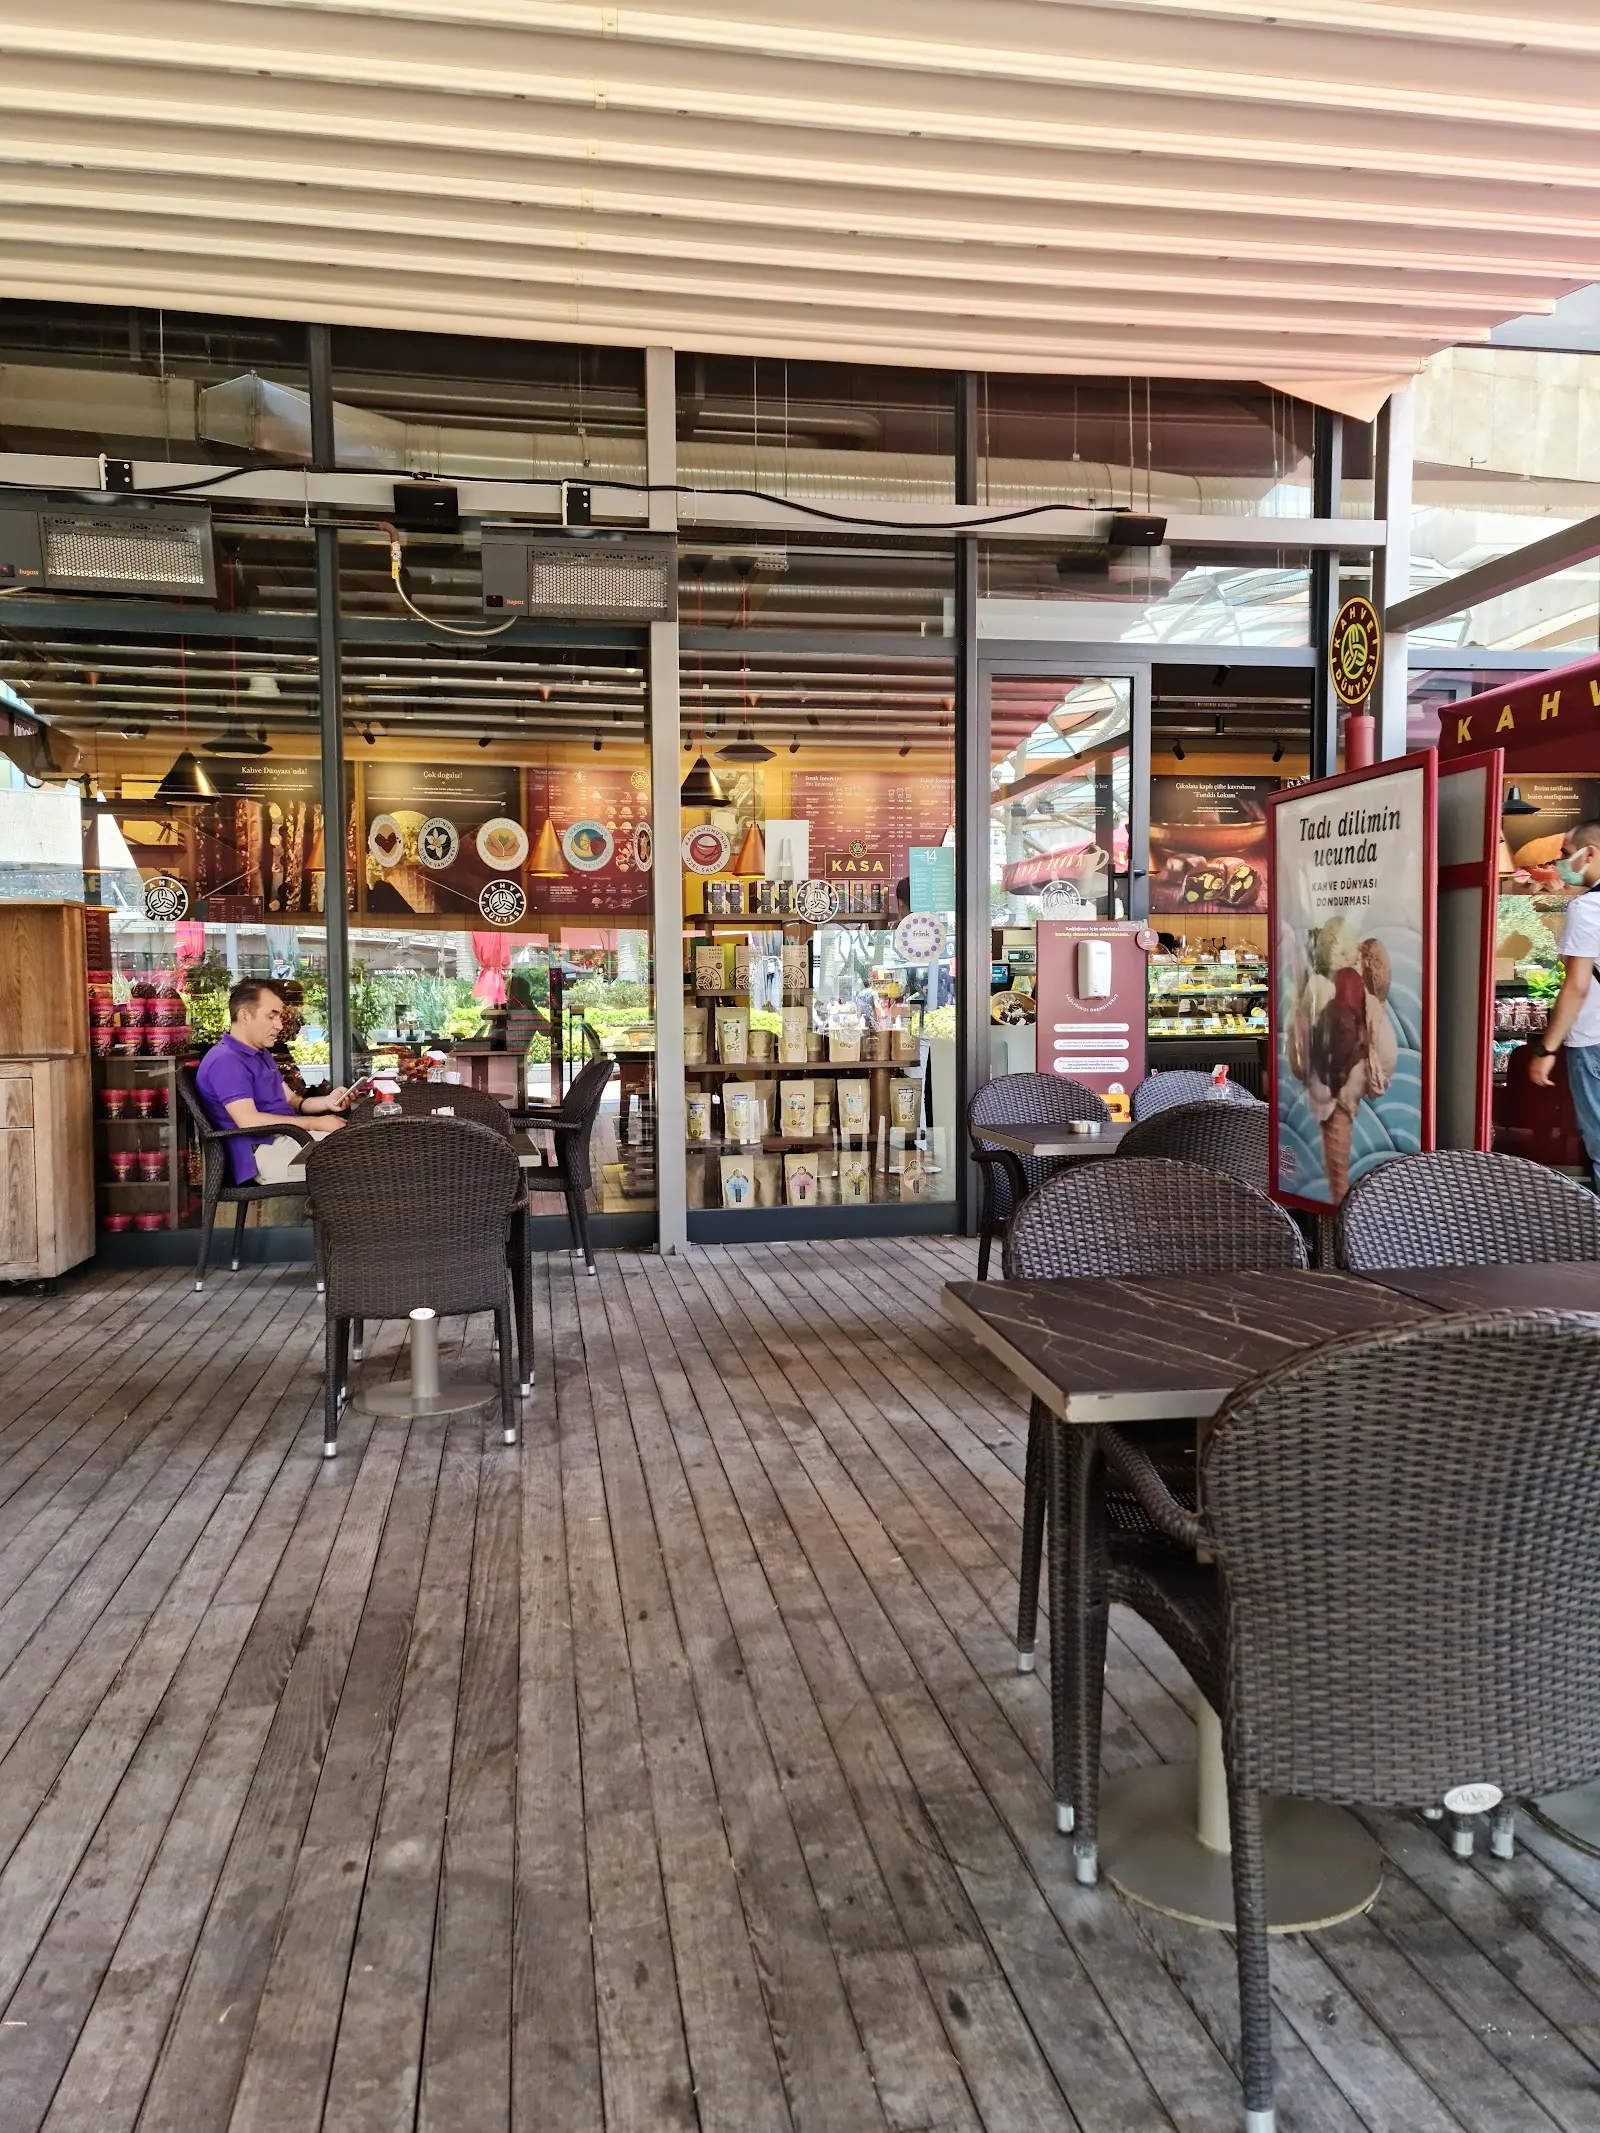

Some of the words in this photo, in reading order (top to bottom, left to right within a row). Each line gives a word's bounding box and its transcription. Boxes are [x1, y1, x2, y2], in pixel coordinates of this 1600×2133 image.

[1334, 606, 1374, 649] KAHVE
[1335, 654, 1376, 697] DÜNYASI
[241, 766, 262, 774] Kahve
[423, 771, 436, 779] Çok
[1300, 815, 1331, 841] Tadı
[1338, 806, 1400, 837] dilimin
[924, 849, 938, 863] 14
[1314, 838, 1377, 867] ucunda
[831, 860, 885, 872] KASA
[484, 882, 522, 899] KAHVE
[799, 882, 835, 898] KAHVE
[1312, 881, 1338, 891] KAHVE
[1340, 878, 1378, 890] DÜNYASI
[1316, 895, 1370, 907] DONDURMASI
[484, 906, 522, 923] DÜNYASI
